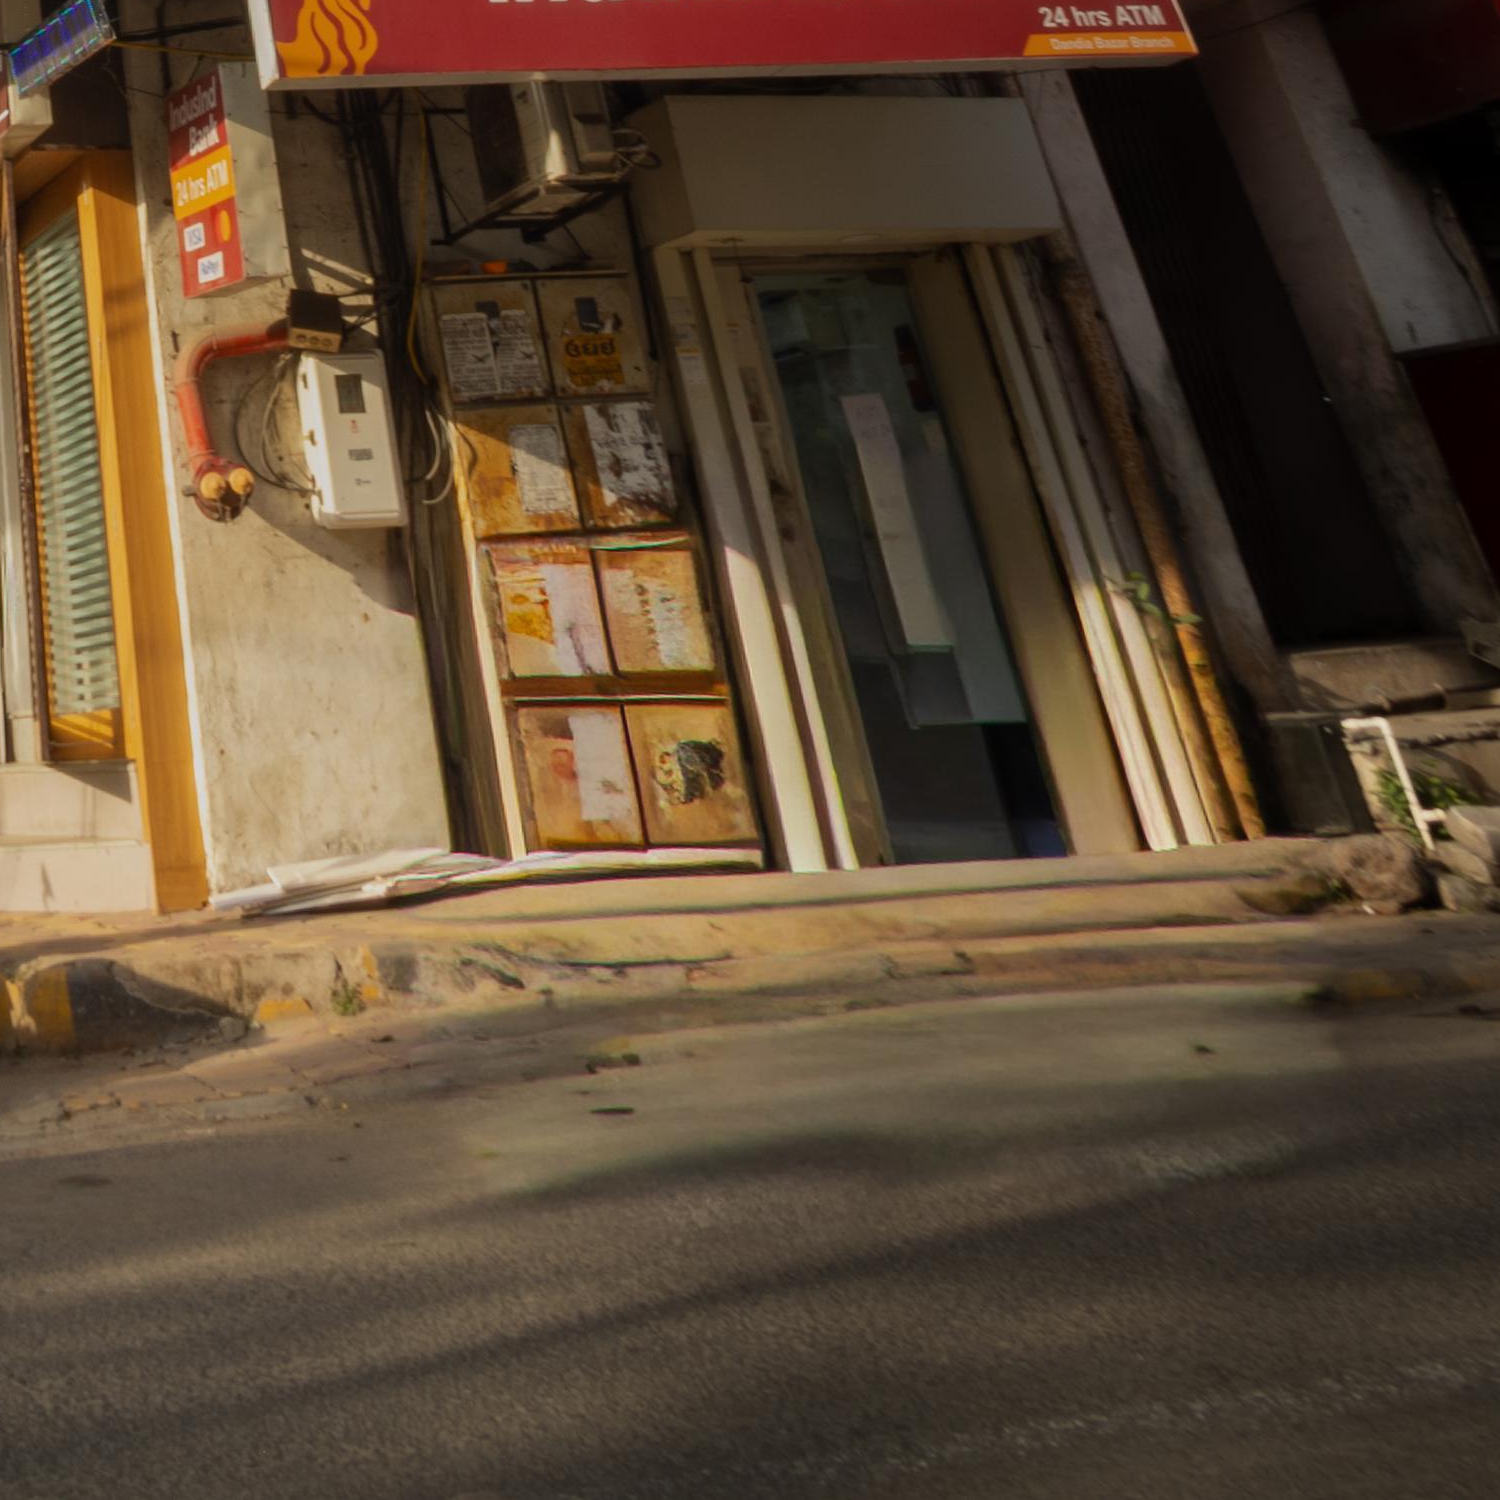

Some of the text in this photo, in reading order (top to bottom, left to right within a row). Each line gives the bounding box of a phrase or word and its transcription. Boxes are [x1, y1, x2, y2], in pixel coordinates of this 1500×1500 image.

[1037, 4, 1167, 28] 24 hrs ATM
[169, 77, 217, 130] IndusInd
[188, 115, 220, 157] Bank
[176, 159, 229, 206] 24 hrs ATM
